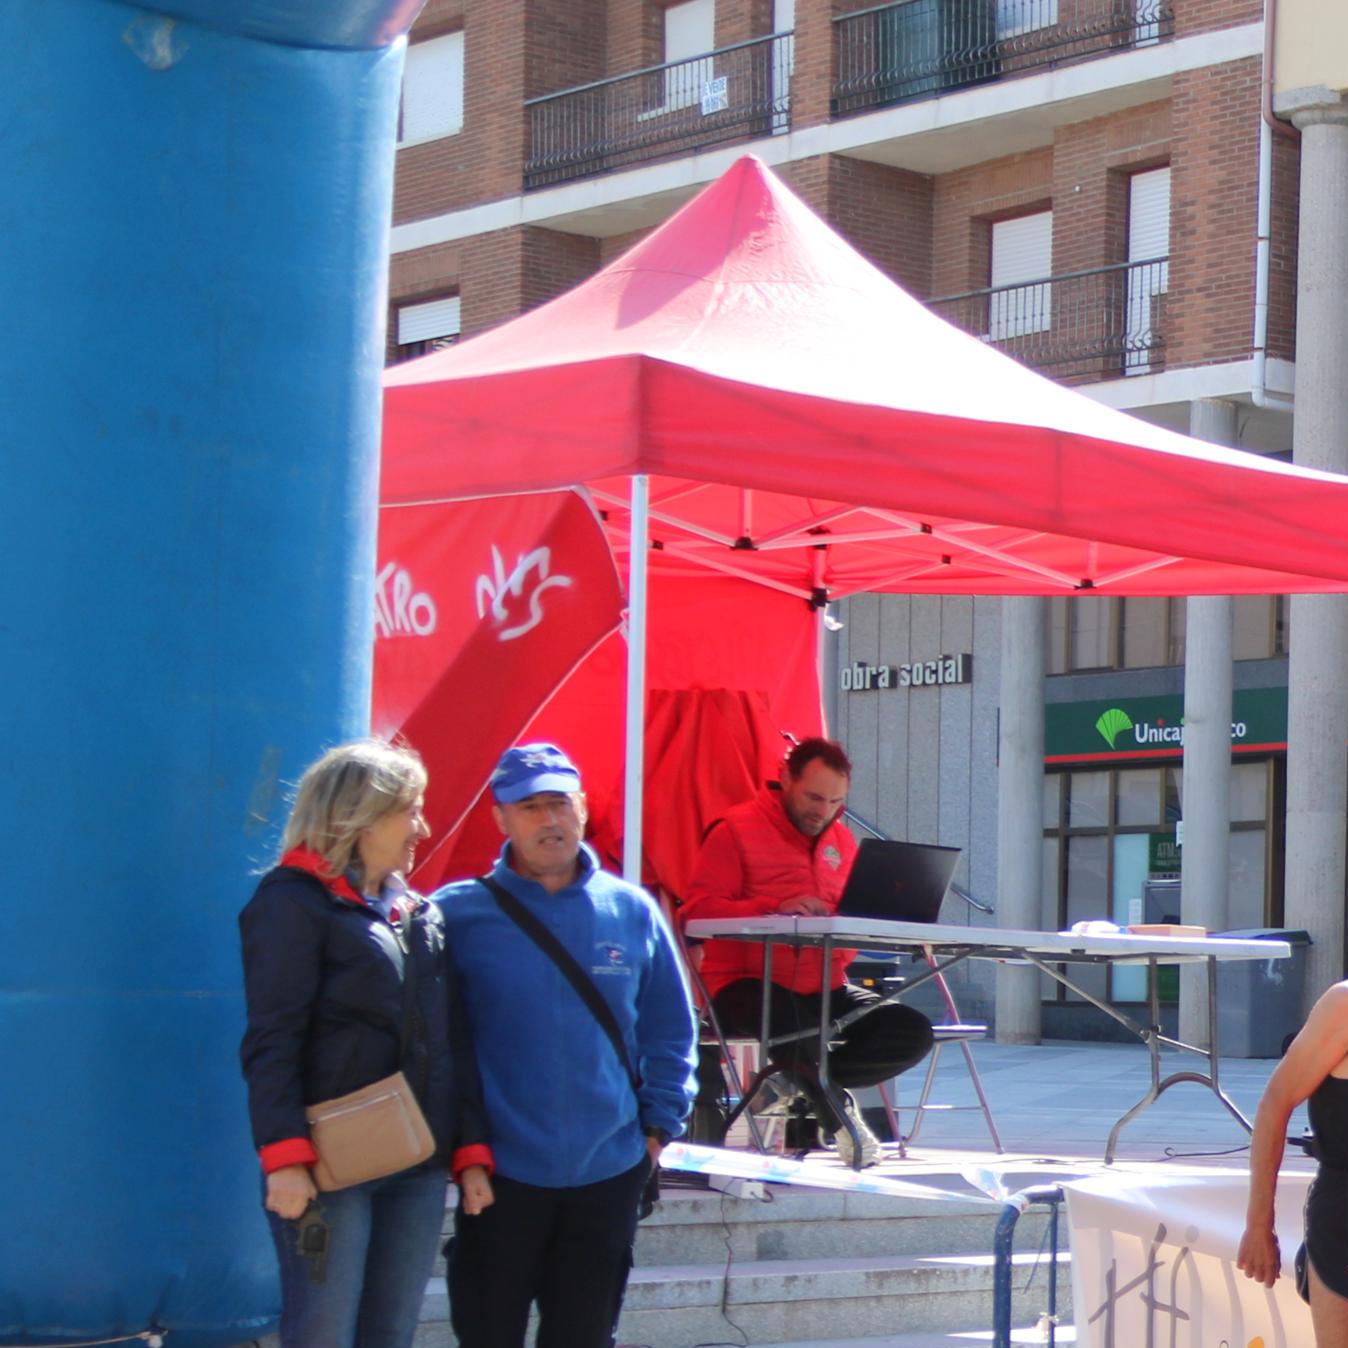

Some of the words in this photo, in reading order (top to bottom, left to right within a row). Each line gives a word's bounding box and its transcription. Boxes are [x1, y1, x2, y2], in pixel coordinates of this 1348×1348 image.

[841, 662, 891, 691] obra
[899, 654, 964, 687] social
[1135, 718, 1184, 746] Unicaj
